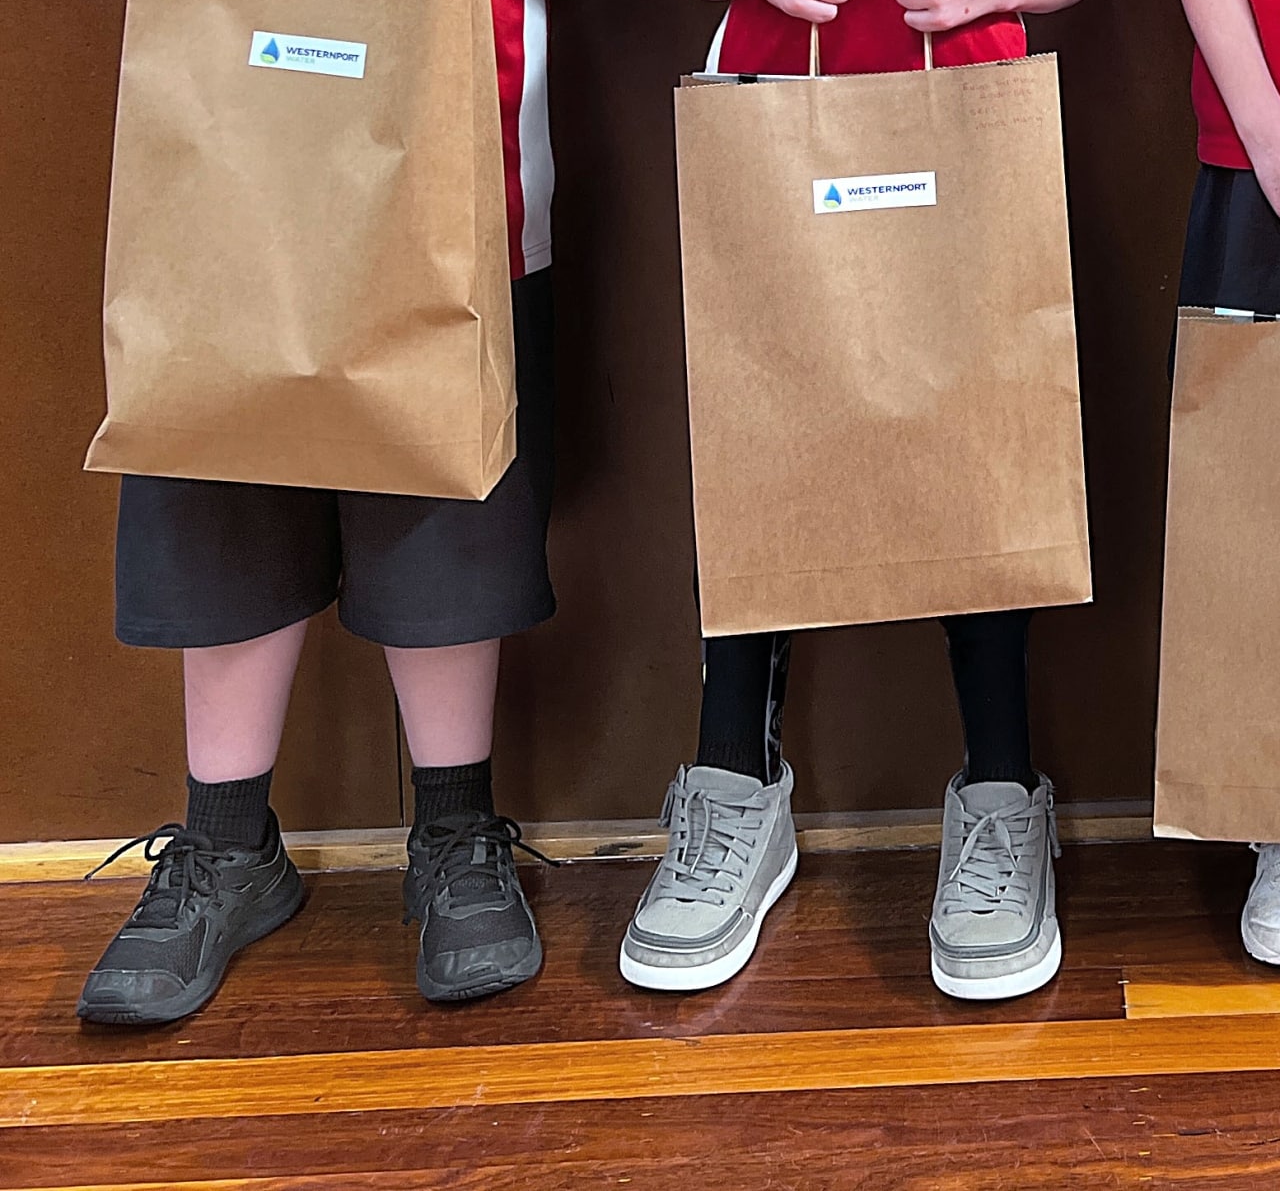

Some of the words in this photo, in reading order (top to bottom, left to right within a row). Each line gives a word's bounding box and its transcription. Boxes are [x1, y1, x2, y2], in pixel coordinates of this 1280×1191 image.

[286, 46, 360, 62] WESTERNPORT
[286, 55, 316, 65] WATER
[847, 182, 927, 196] WESTERNPORT
[849, 194, 879, 203] WATER
